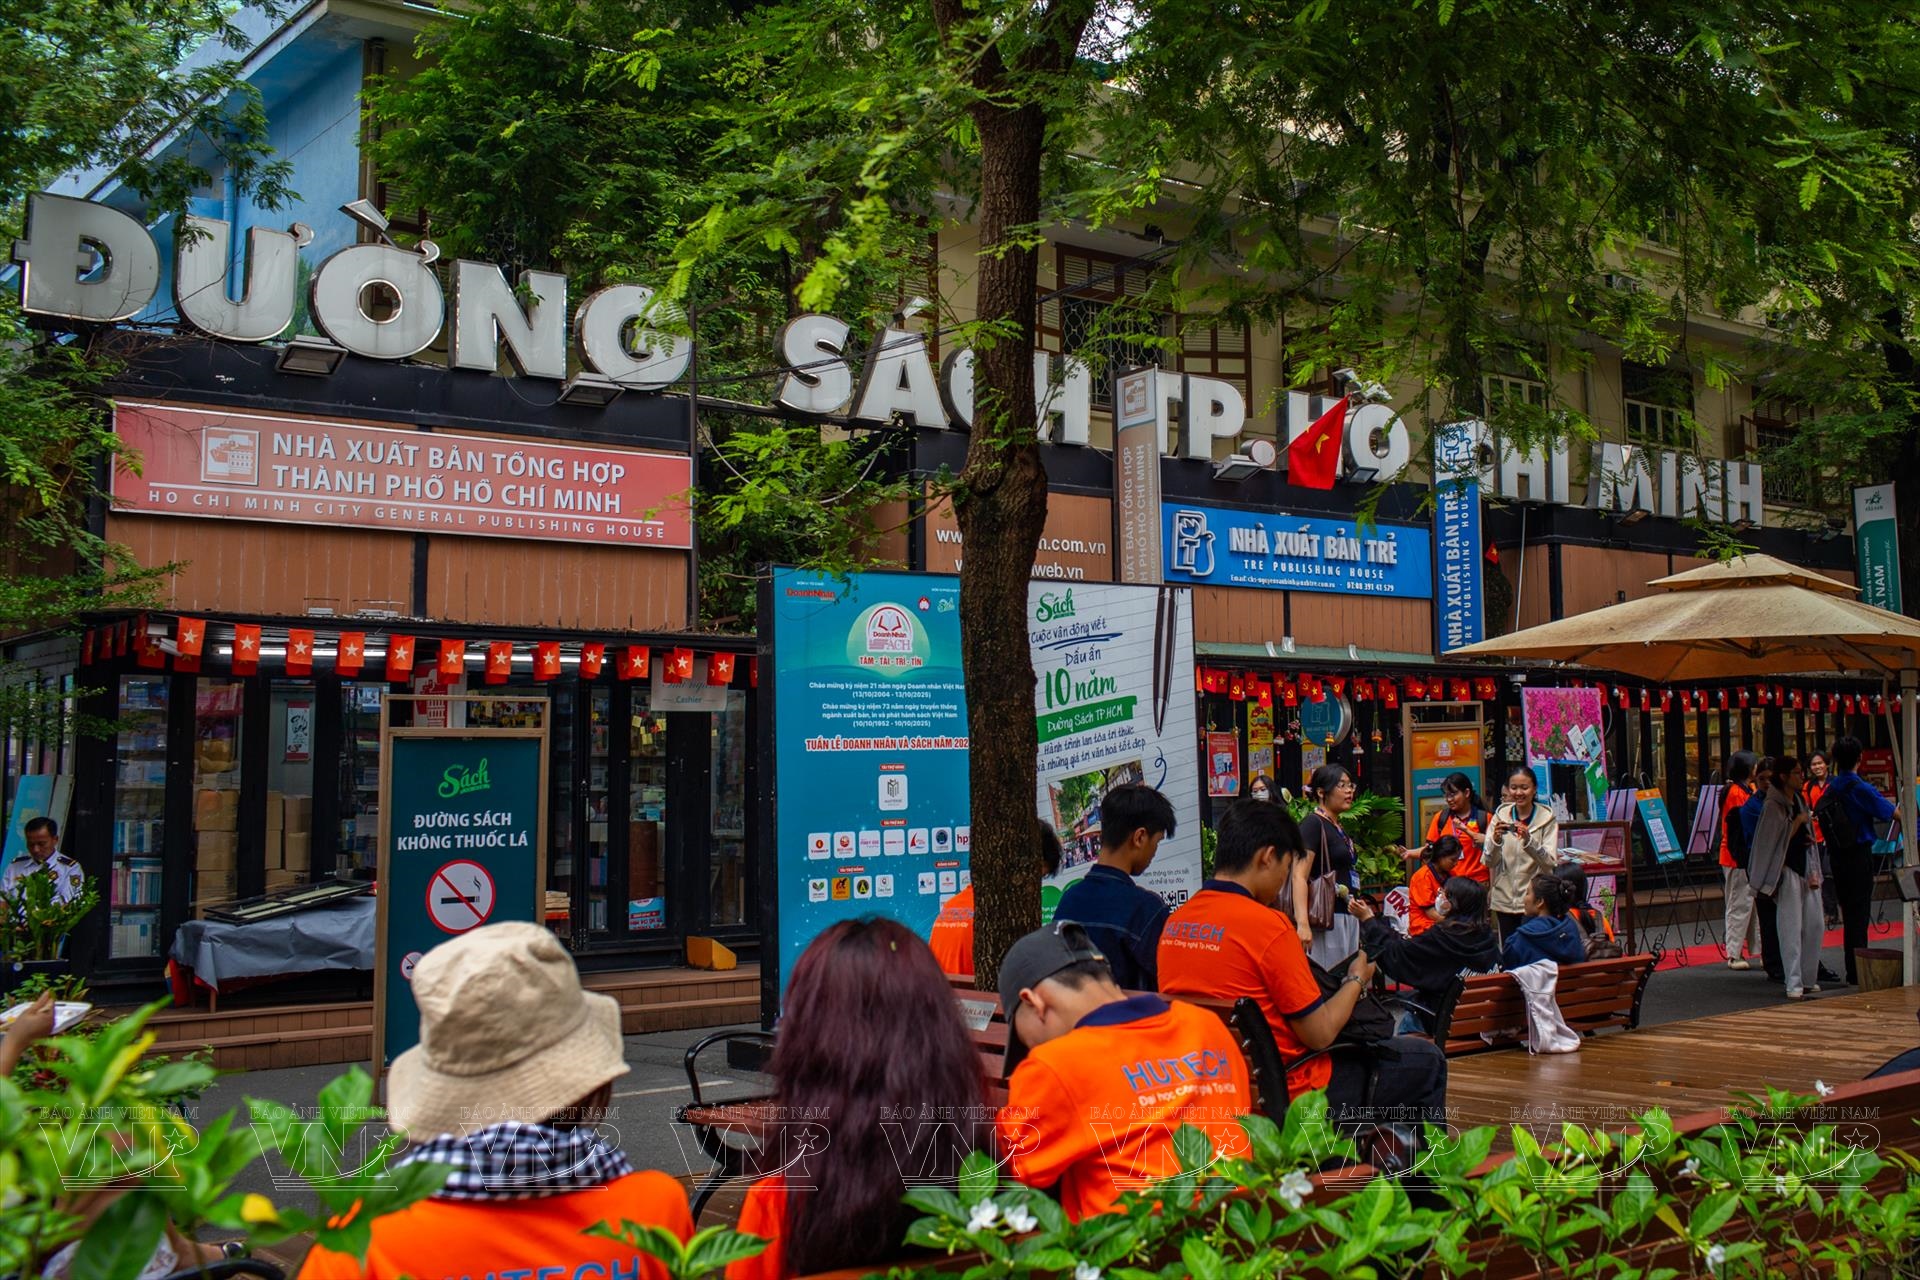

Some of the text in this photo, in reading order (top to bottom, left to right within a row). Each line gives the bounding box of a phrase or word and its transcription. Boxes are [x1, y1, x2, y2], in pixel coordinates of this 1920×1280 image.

[13, 193, 693, 391] ĐƯỜNG
[1587, 440, 1762, 529] MINH
[272, 432, 626, 487] NHÀ XUẤT BẢN TỔNG HỢP
[1122, 447, 1133, 475] HỢP
[1136, 445, 1146, 481] MINH
[272, 464, 622, 514] THÀNH PHỐ HỒ CHÍ MINH
[1135, 484, 1146, 509] CHÍ
[149, 490, 665, 538] HO CHI MINH CITY GENERAL PUBLISHING HOUSE
[1135, 512, 1147, 533] HỒ
[1135, 536, 1148, 567] PHỐ
[1228, 522, 1398, 565] NHÀ XUẤT BẢN TRẺ
[1243, 559, 1384, 580] TRE PUBLISHING HOUSE
[1439, 489, 1463, 646] NHÀ XUẤT BẢN TRẺ
[1462, 539, 1471, 617] PUBLISHING
[1874, 564, 1886, 597] NAM
[1036, 587, 1075, 622] Sách
[1031, 629, 1051, 643] Cuộc
[1053, 626, 1068, 641] vận
[1070, 622, 1090, 637] động
[1091, 615, 1106, 630] viết
[1065, 643, 1102, 667] Dấu ấn
[809, 682, 826, 690] Chào
[827, 682, 844, 690] mừng
[854, 682, 869, 690] niệm
[870, 682, 877, 690] 21
[878, 682, 891, 690] năm
[892, 682, 906, 690] ngày
[908, 682, 926, 690] Doanh
[927, 682, 941, 690] nhân
[943, 682, 954, 690] Việt
[1045, 668, 1117, 709] 10 năm
[822, 703, 838, 711] Chào
[840, 703, 857, 711] mừng
[867, 703, 881, 711] niệm
[882, 703, 890, 711] 73
[891, 703, 904, 711] năm
[905, 703, 919, 711] ngày
[920, 703, 939, 711] truyền
[940, 703, 957, 711] thống
[822, 711, 842, 719] ngành
[843, 711, 857, 719] xuất
[887, 711, 900, 719] phát
[901, 711, 916, 719] hành
[917, 711, 930, 719] sách
[932, 711, 943, 719] Việt
[944, 711, 958, 719] Nam
[1047, 718, 1073, 733] Đường
[1074, 713, 1094, 728] Sách
[806, 735, 968, 750] TUẦN LỄ DOANH NHÂN VÀ SÁCH NĂM 202
[1037, 758, 1046, 772] và
[1047, 754, 1069, 771] những
[1069, 752, 1080, 768] giá
[1081, 749, 1091, 763] trị
[1091, 746, 1104, 759] văn
[1118, 739, 1131, 753] tốt
[1132, 737, 1146, 752] đẹp
[1044, 741, 1063, 755] Hành
[1063, 736, 1081, 750] trình
[1082, 735, 1093, 747] lan
[438, 757, 490, 798] Sách
[413, 810, 512, 828] ĐƯỜNG SÁCH
[397, 829, 528, 850] KHÔNG THUỐC LÁ
[1121, 1048, 1231, 1092] HUTECH
